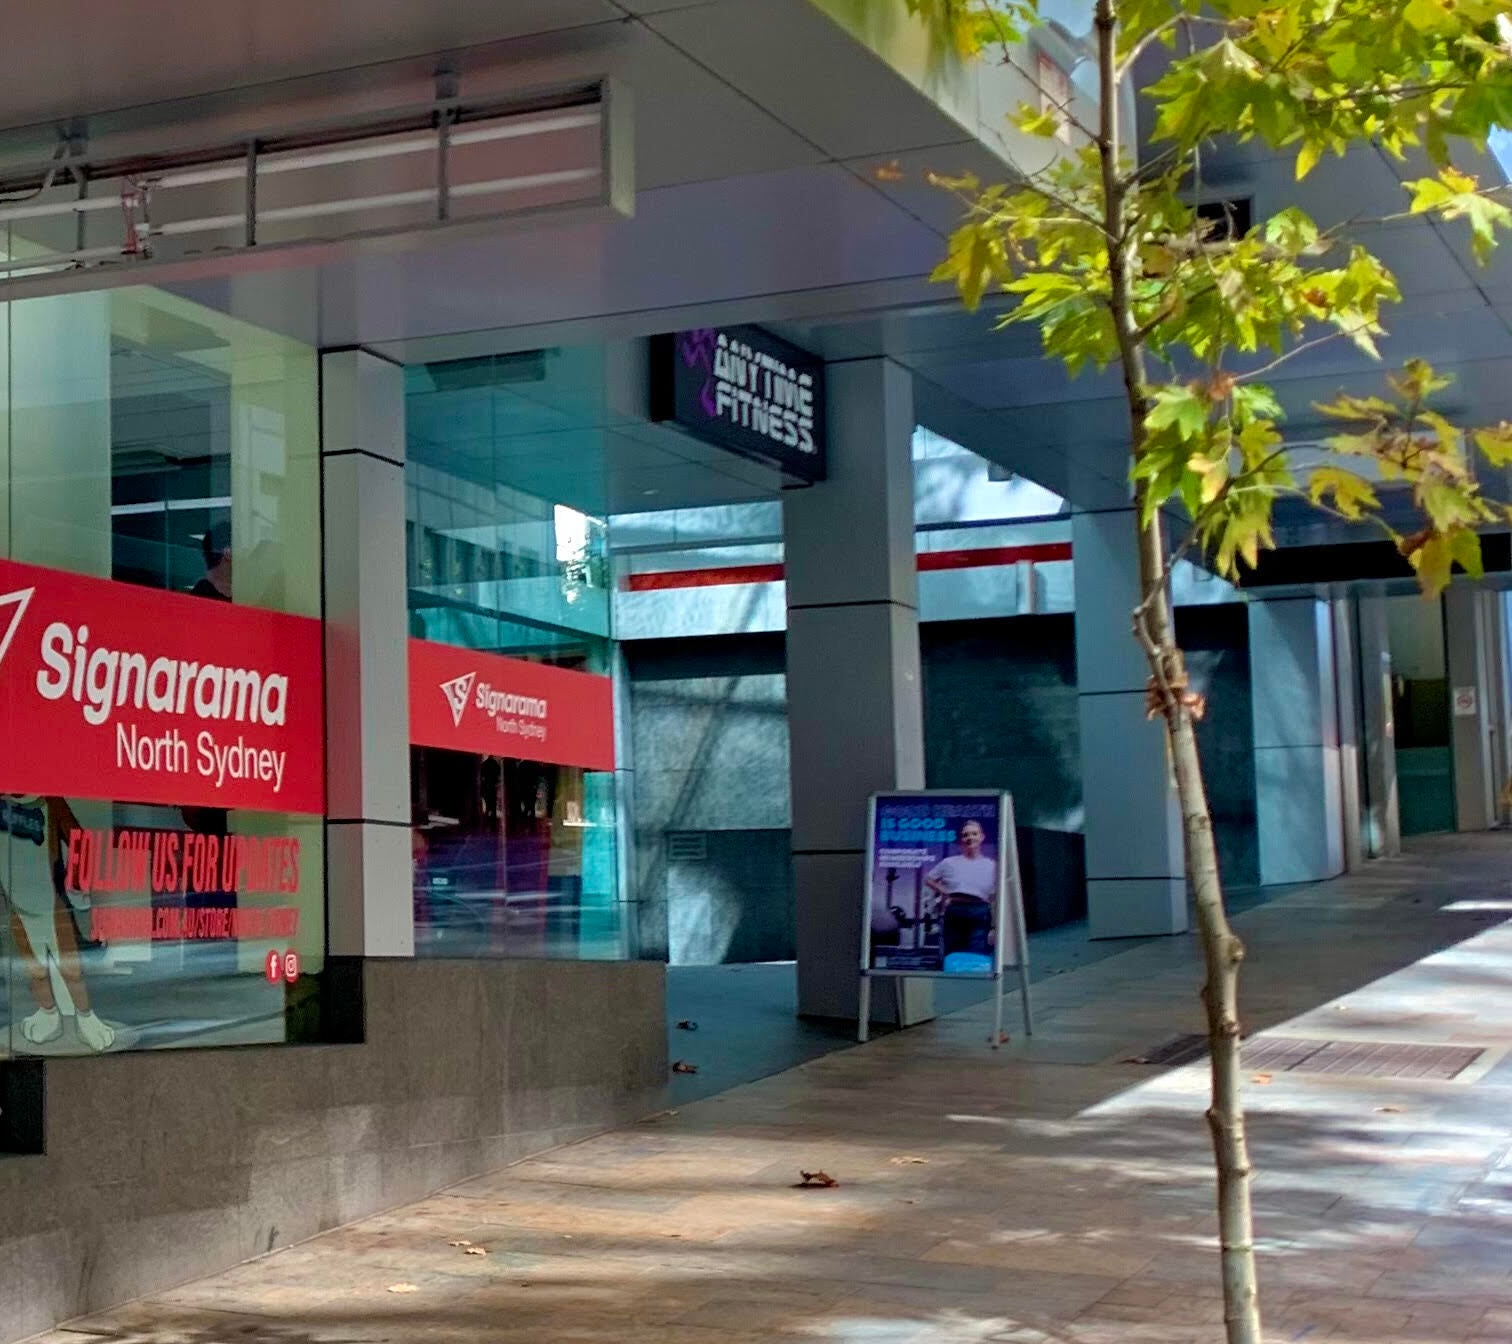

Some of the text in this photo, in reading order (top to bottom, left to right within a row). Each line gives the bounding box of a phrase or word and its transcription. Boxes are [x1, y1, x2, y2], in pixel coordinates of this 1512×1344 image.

[713, 333, 814, 417] ANYTIME
[715, 380, 814, 453] FITNESS
[36, 622, 288, 726] Signarama
[475, 682, 548, 718] Signarama
[116, 722, 286, 792] North Sydney
[65, 828, 151, 893] FOLLOW
[151, 832, 180, 893] US
[183, 833, 219, 893] FOR
